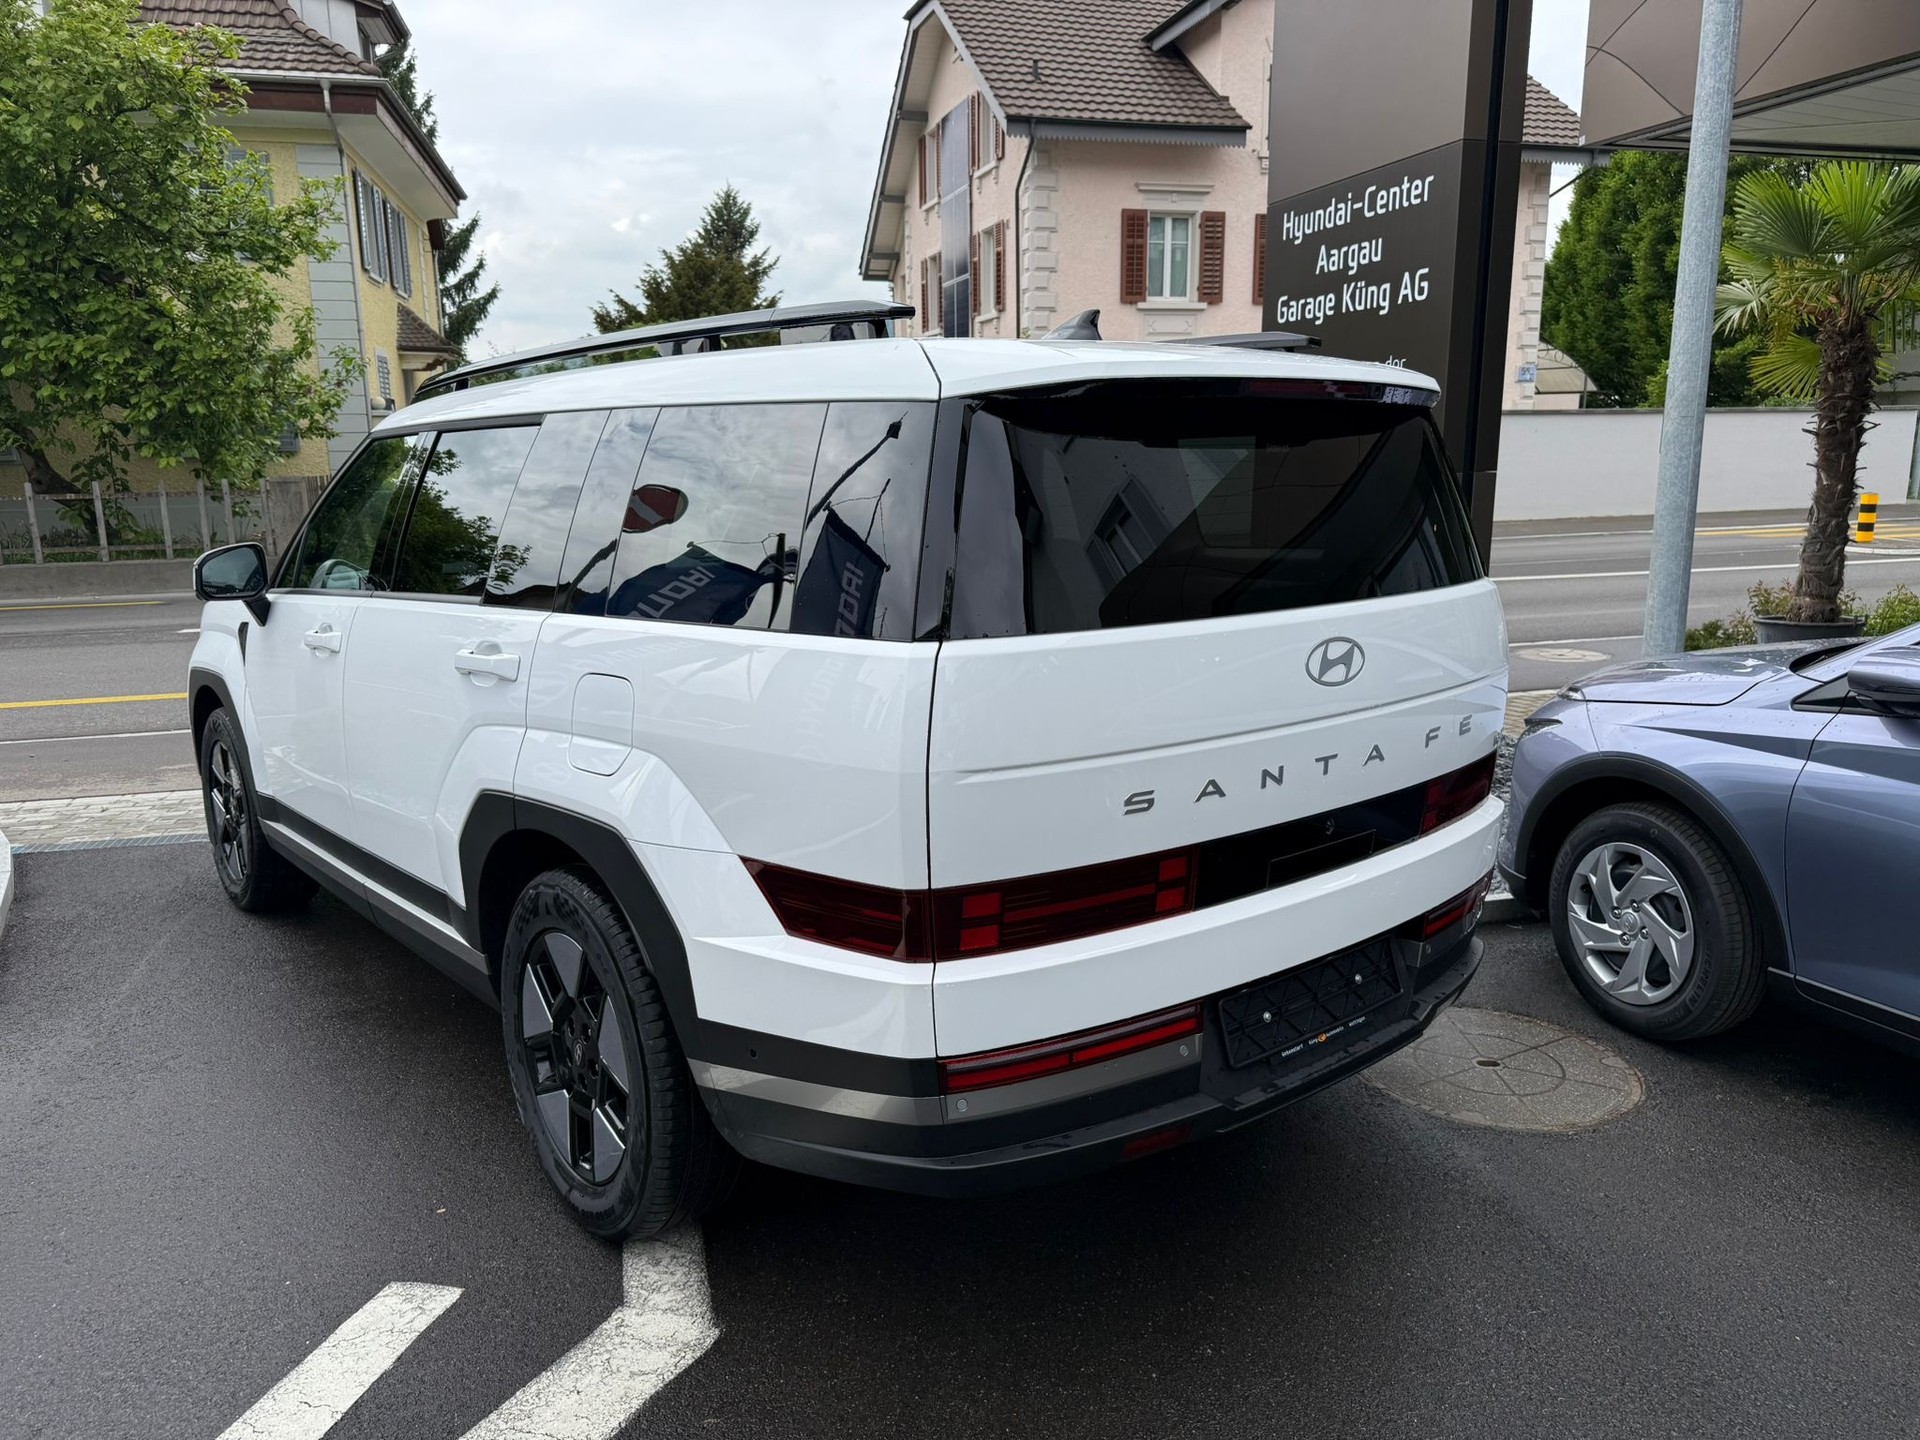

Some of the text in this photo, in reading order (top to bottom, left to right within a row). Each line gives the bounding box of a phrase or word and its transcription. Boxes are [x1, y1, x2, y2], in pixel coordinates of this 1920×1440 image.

[1282, 175, 1435, 245] Hyundai-Center
[1315, 237, 1383, 275] Aargau
[1276, 267, 1430, 325] Garage Küng AG
[1123, 714, 1473, 817] SANTA FE
